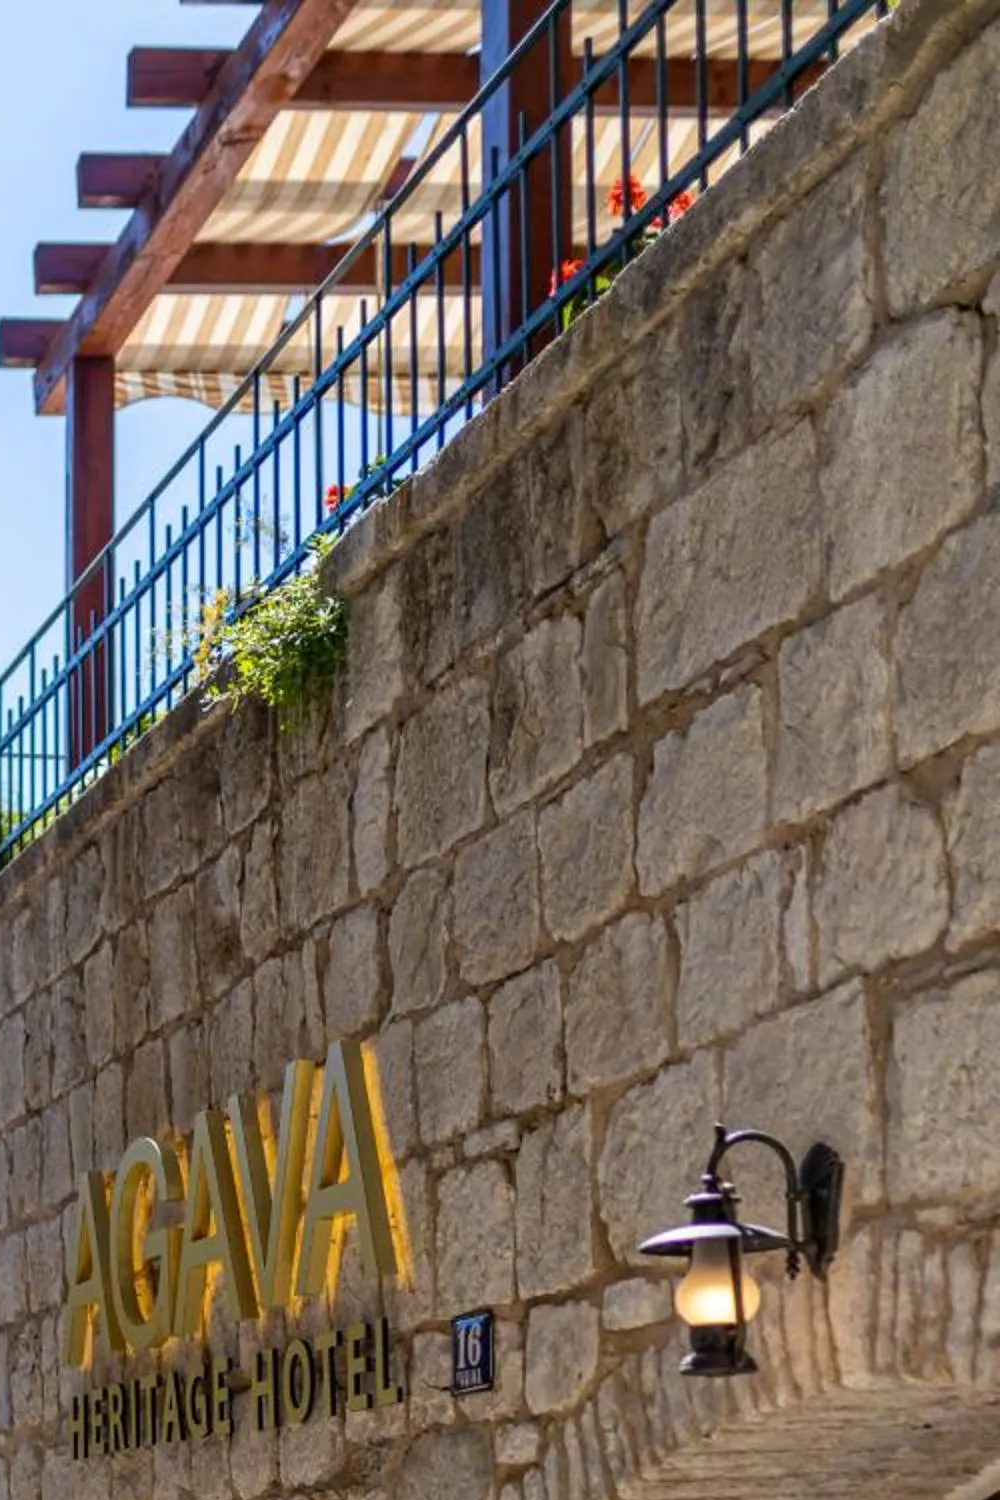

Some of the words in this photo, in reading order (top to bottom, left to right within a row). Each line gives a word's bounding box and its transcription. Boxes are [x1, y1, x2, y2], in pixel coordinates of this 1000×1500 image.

[62, 1038, 398, 1367] AGAVA
[70, 1357, 234, 1460] HERITAGE
[250, 1317, 404, 1432] HOTEL
[457, 1322, 481, 1369] 16
